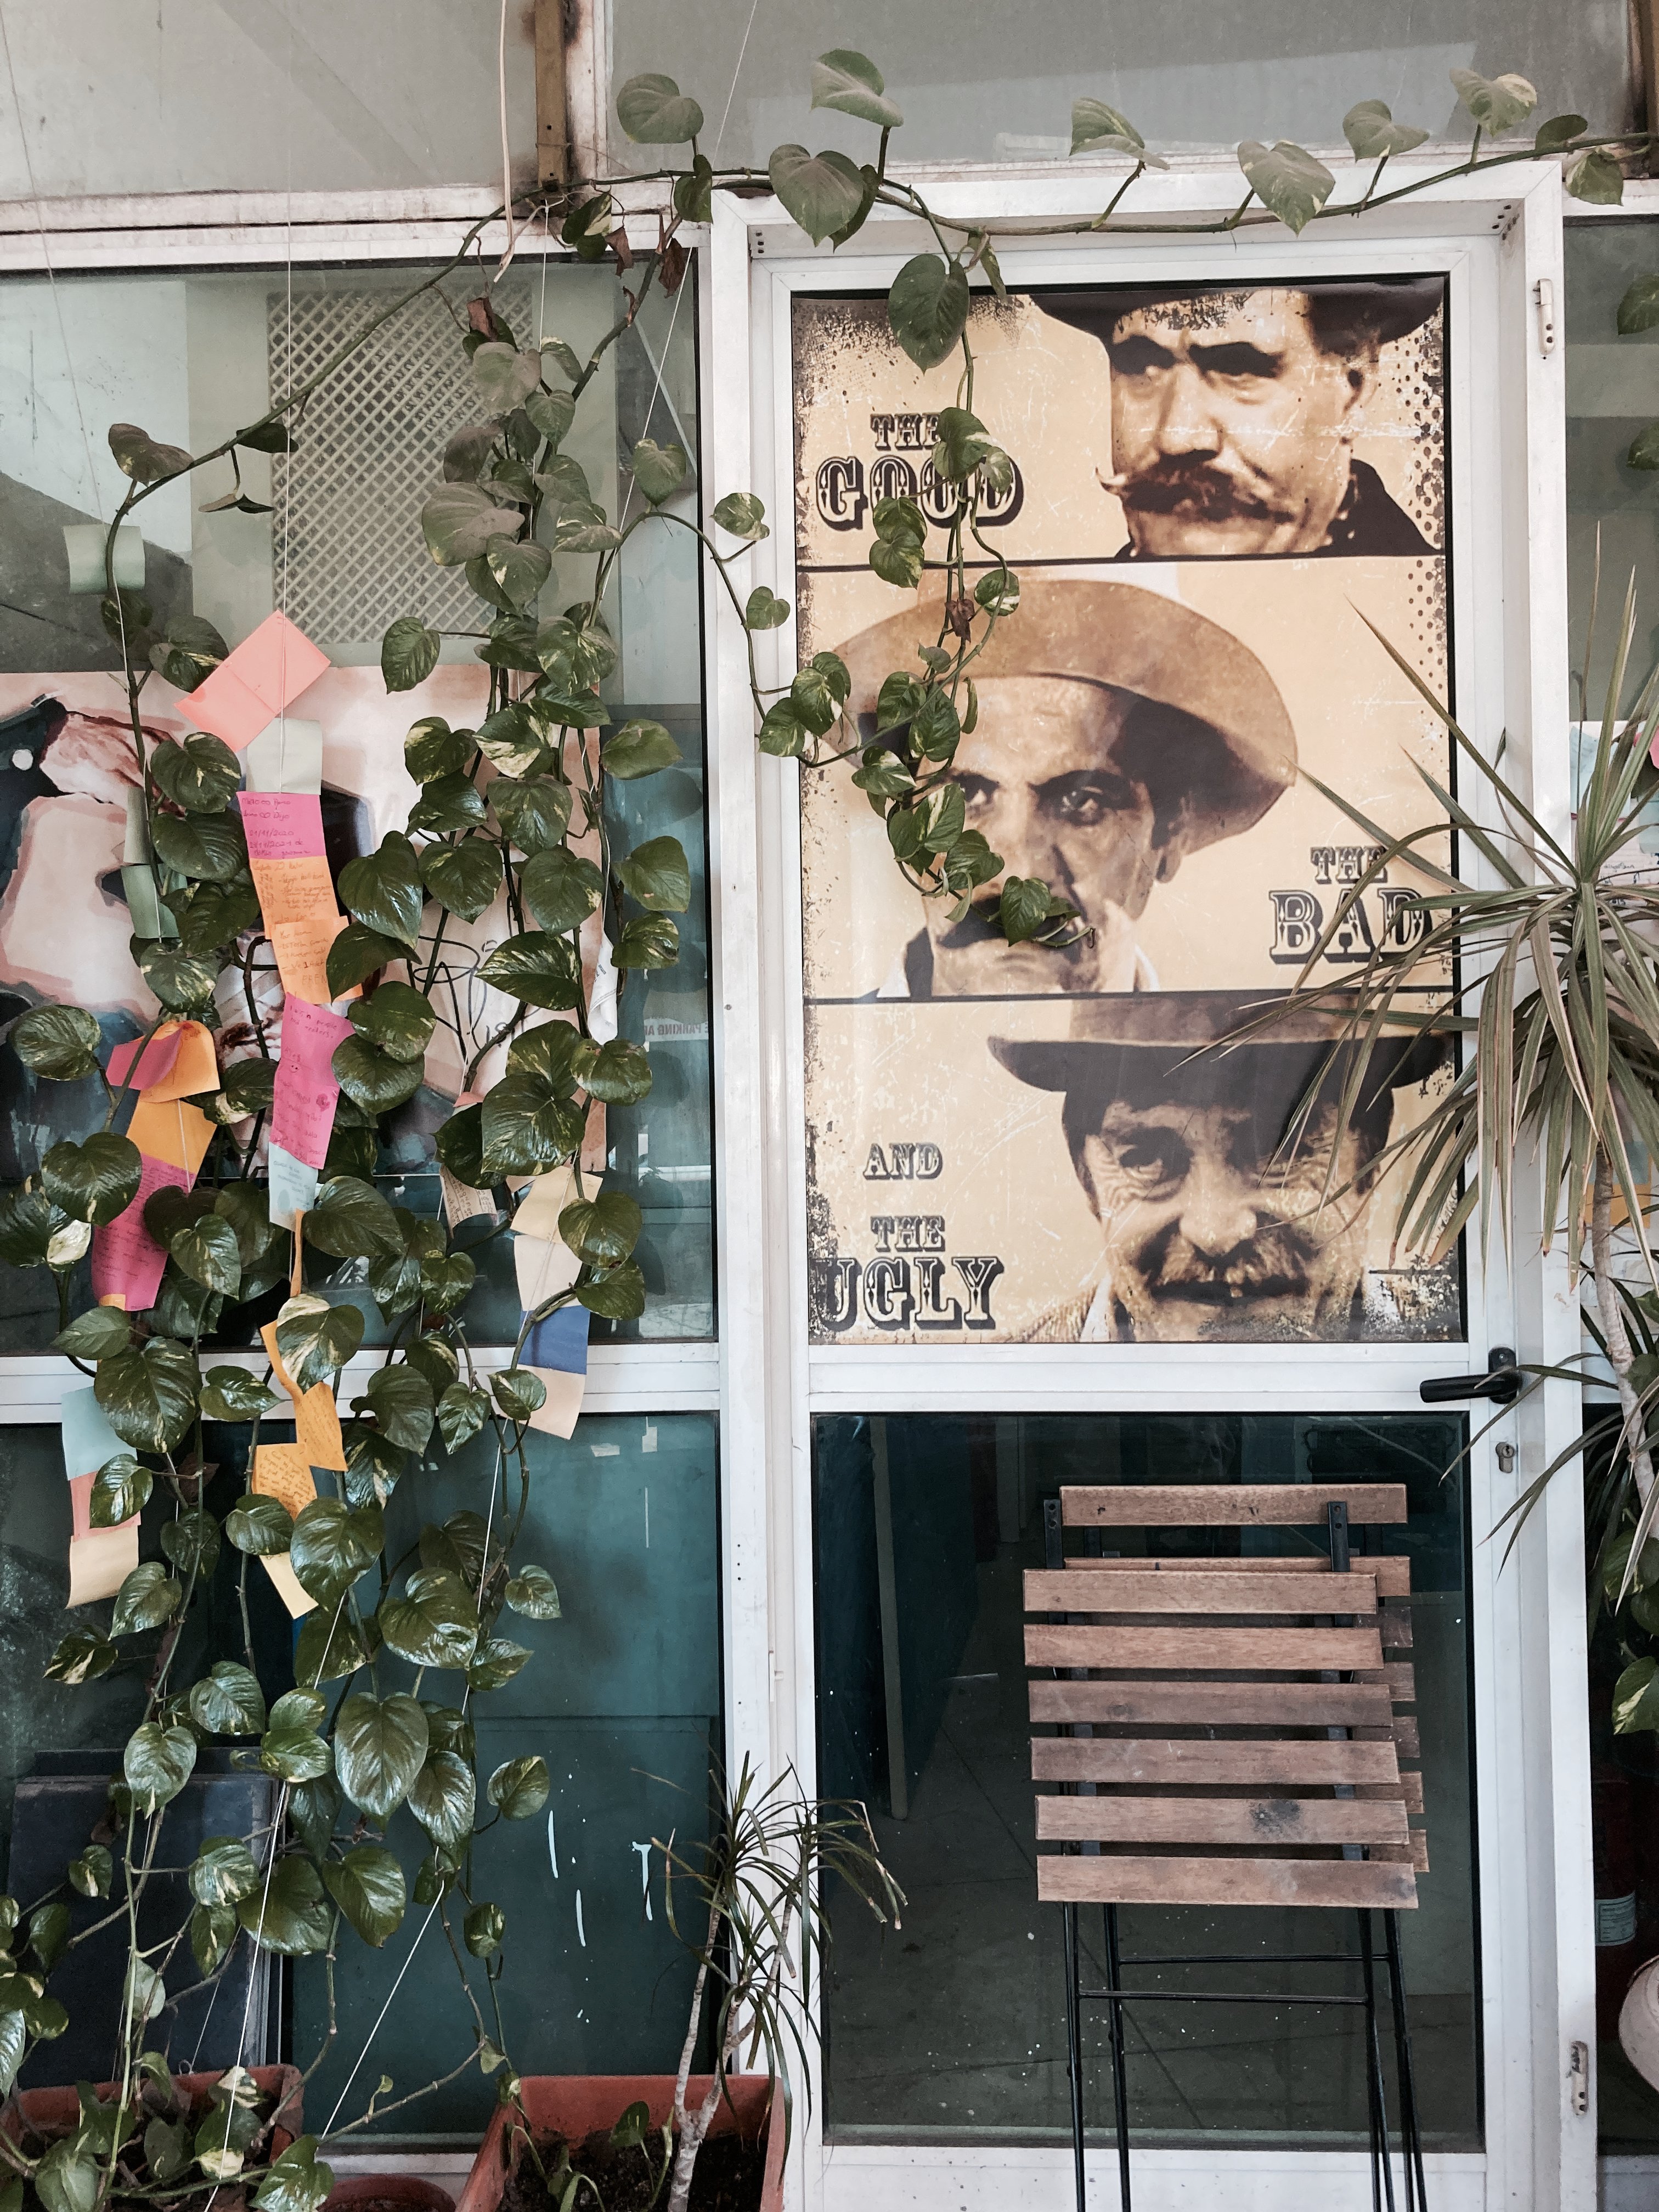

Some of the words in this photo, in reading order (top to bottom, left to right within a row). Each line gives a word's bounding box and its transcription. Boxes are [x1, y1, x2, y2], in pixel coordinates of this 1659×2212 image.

[870, 413, 940, 451] THE
[816, 455, 1024, 531] GOOD
[1310, 846, 1387, 884] THE
[1268, 888, 1433, 964] BAD
[863, 1143, 943, 1180] AND
[870, 1216, 946, 1252] THE
[809, 1256, 1005, 1331] UGLY
